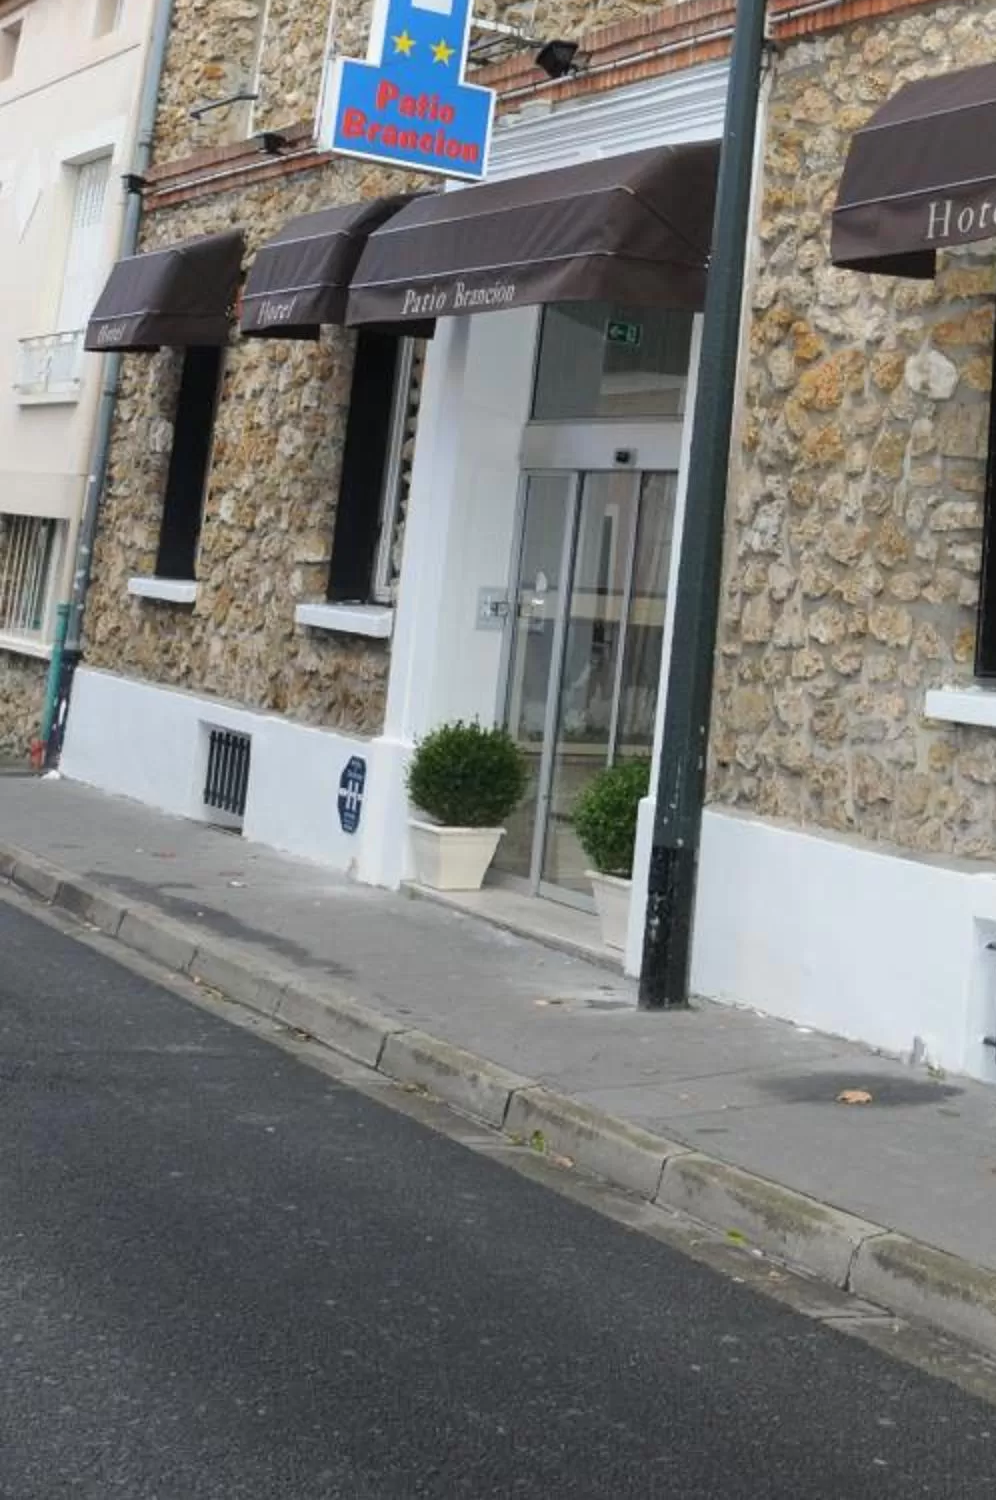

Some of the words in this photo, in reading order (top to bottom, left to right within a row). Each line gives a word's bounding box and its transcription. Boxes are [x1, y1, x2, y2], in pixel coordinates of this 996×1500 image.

[375, 78, 456, 124] Patio
[341, 105, 479, 164] Brancion
[256, 296, 297, 325] Hotel
[400, 285, 447, 315] Patio
[453, 280, 515, 308] Brancion
